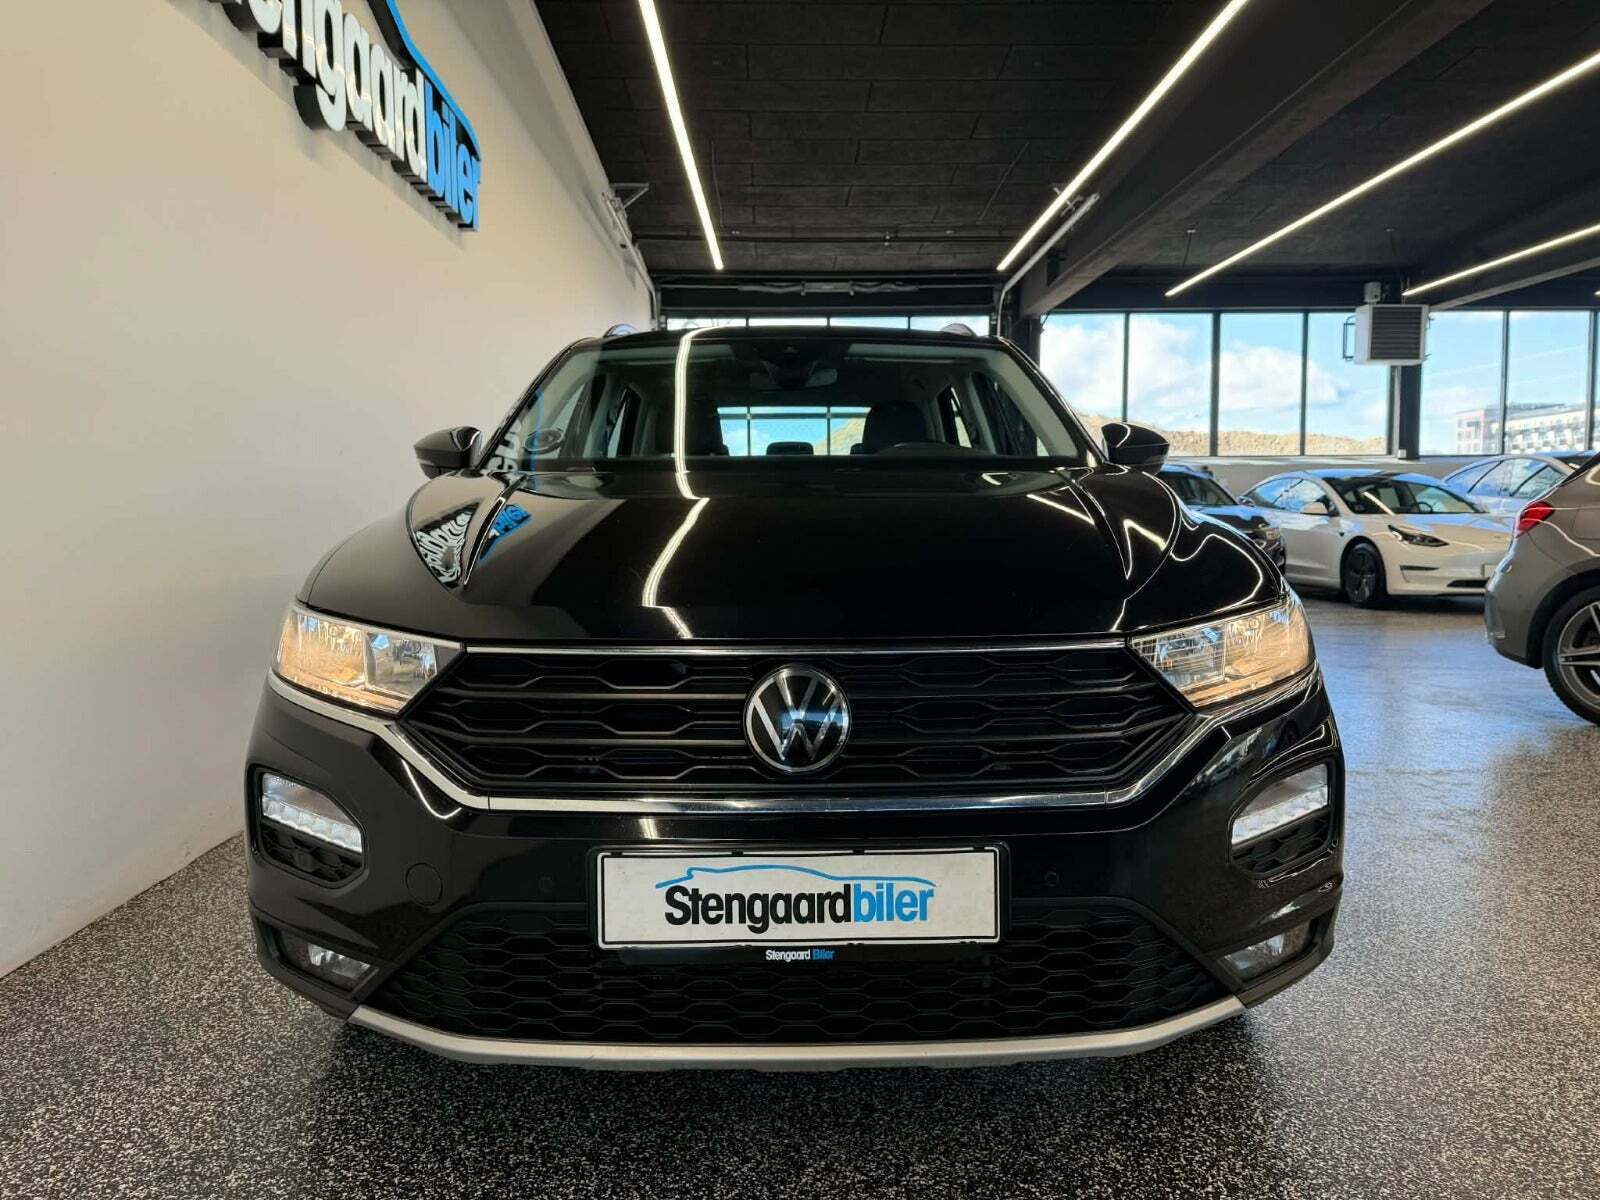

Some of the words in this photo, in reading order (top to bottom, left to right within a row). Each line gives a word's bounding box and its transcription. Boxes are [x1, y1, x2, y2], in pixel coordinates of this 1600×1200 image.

[751, 669, 842, 762] VW
[665, 883, 934, 934] Stengaardbiler
[765, 949, 811, 962] Stengaard
